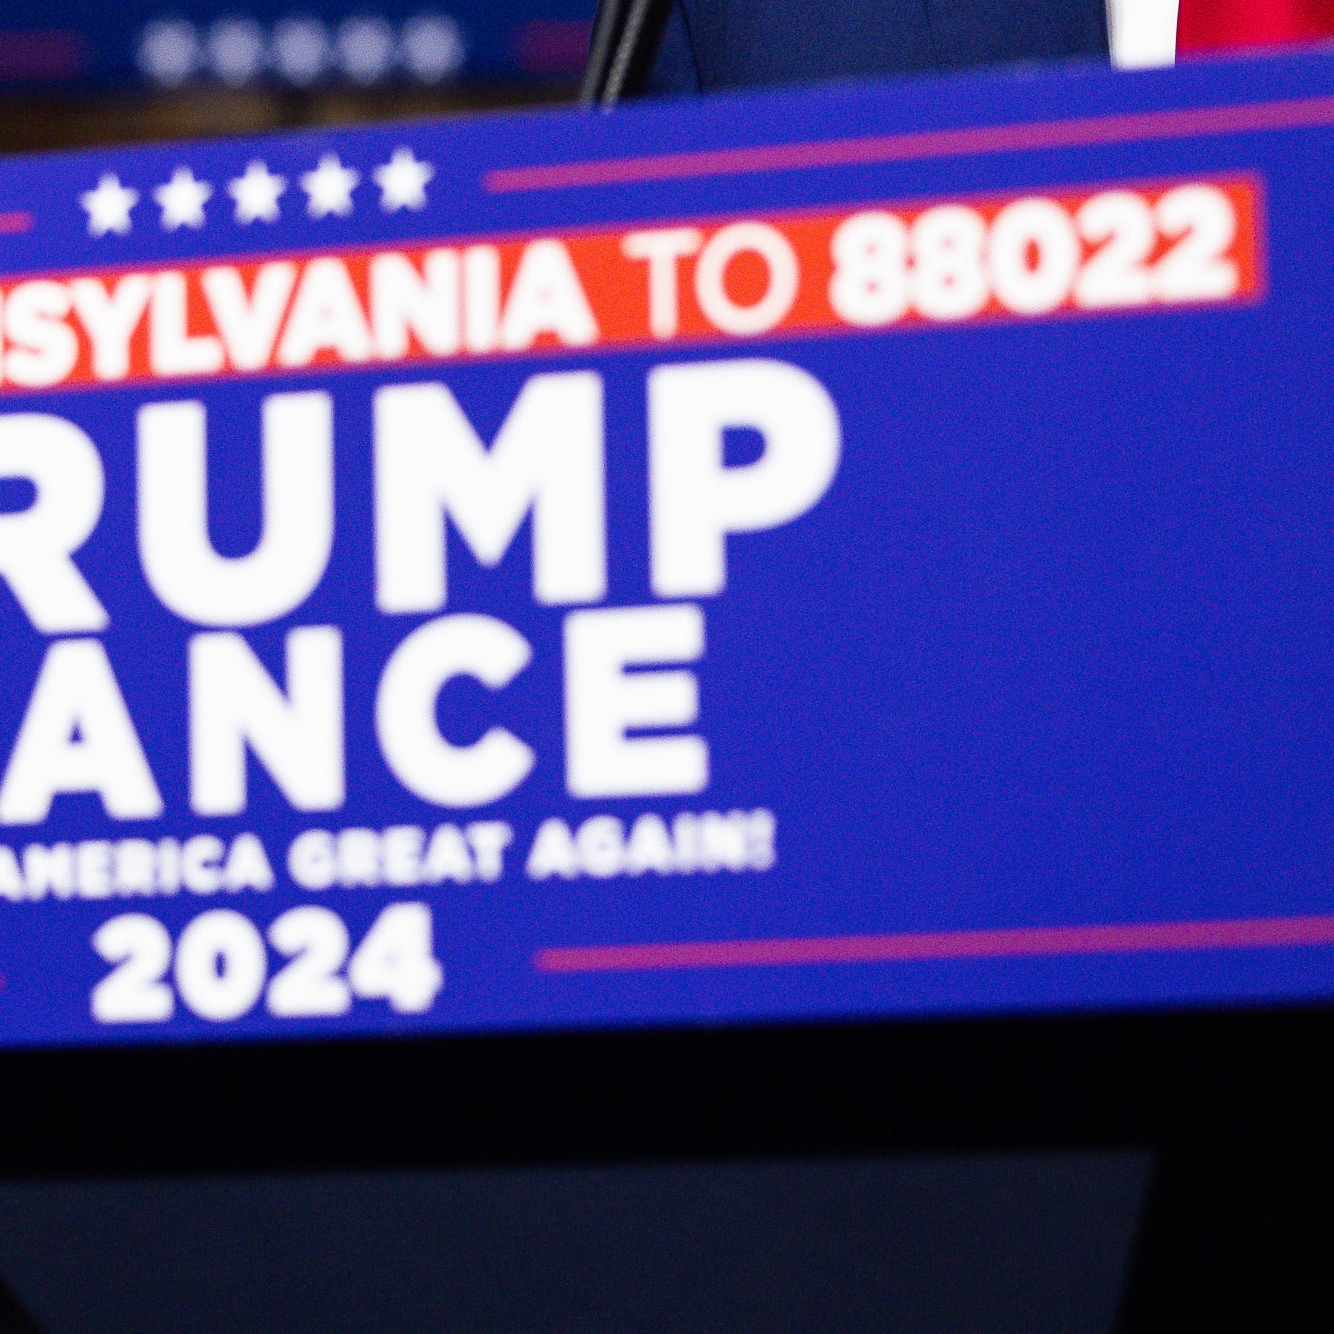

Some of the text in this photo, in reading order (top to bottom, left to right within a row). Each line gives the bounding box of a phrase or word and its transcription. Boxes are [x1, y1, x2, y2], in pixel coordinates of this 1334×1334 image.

[620, 220, 801, 341] TO
[826, 182, 1241, 329] 88022
[286, 820, 514, 891] GREAT
[525, 808, 777, 880] AGAIN!
[90, 900, 445, 1024] 2024
